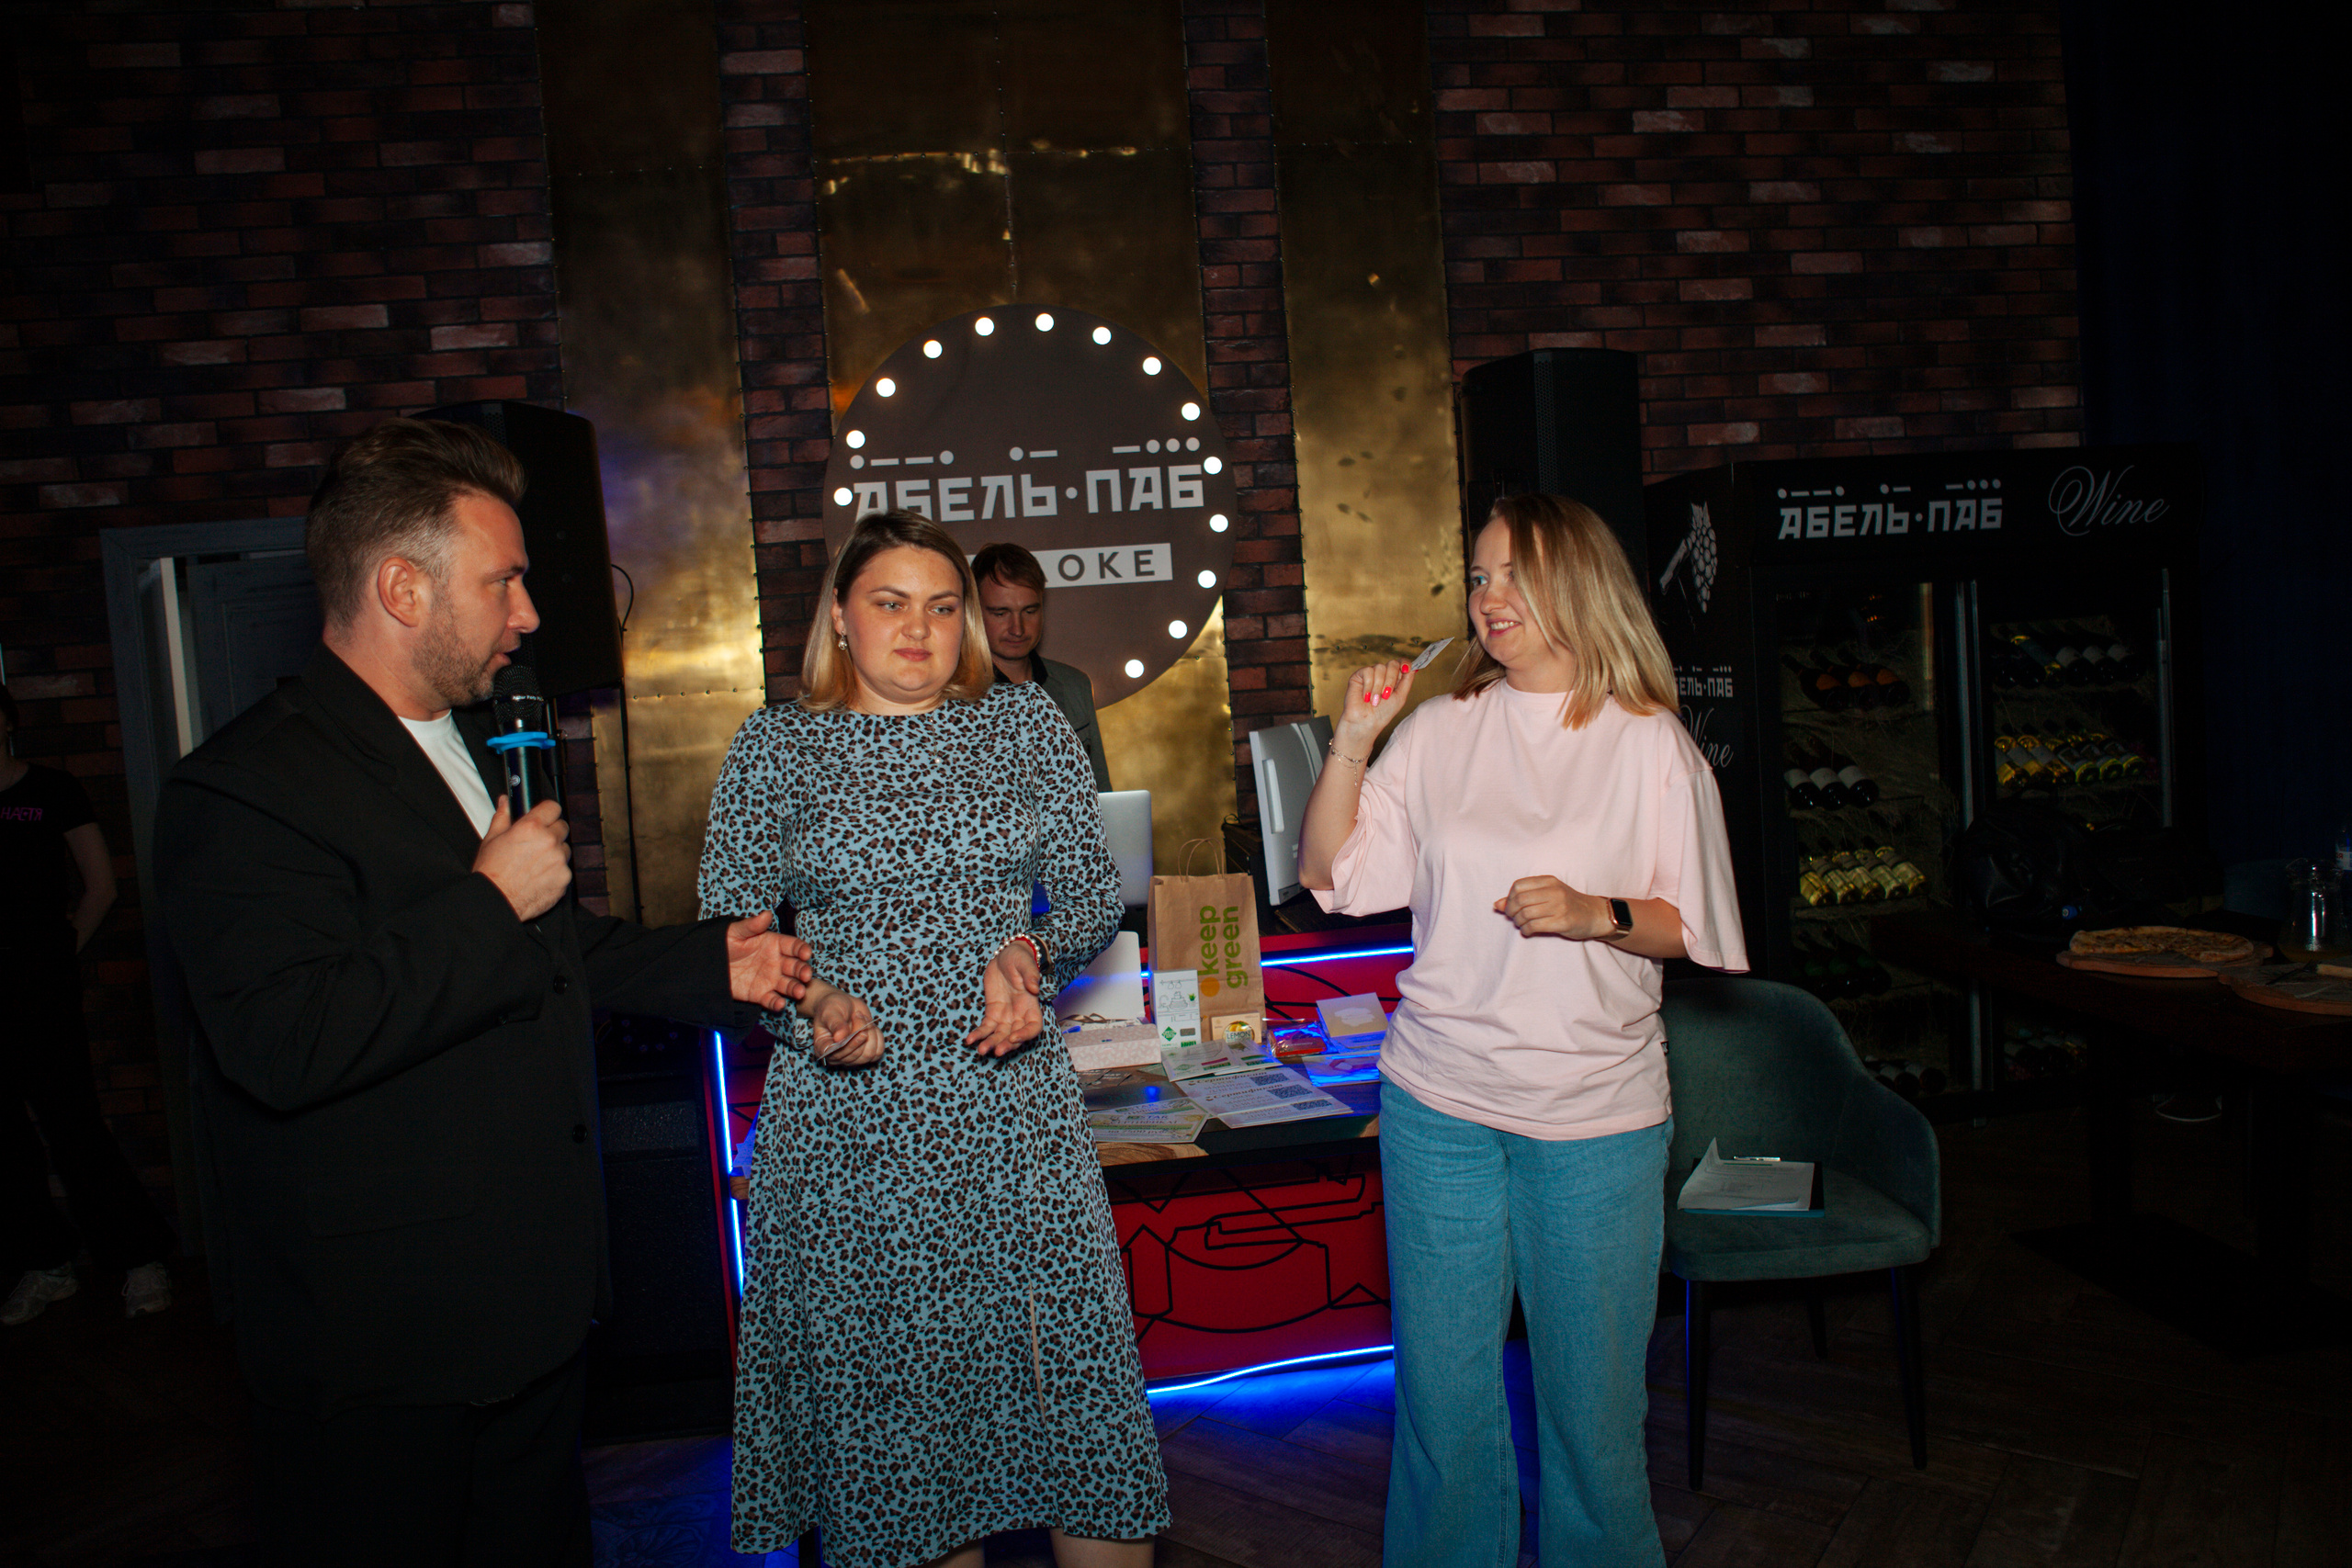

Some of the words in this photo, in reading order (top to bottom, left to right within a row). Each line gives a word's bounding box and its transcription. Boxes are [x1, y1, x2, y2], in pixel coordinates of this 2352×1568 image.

[2048, 464, 2171, 536] Wine
[1197, 906, 1221, 976] keep
[1223, 906, 1249, 988] green
[1227, 1030, 1250, 1040] LEMON
